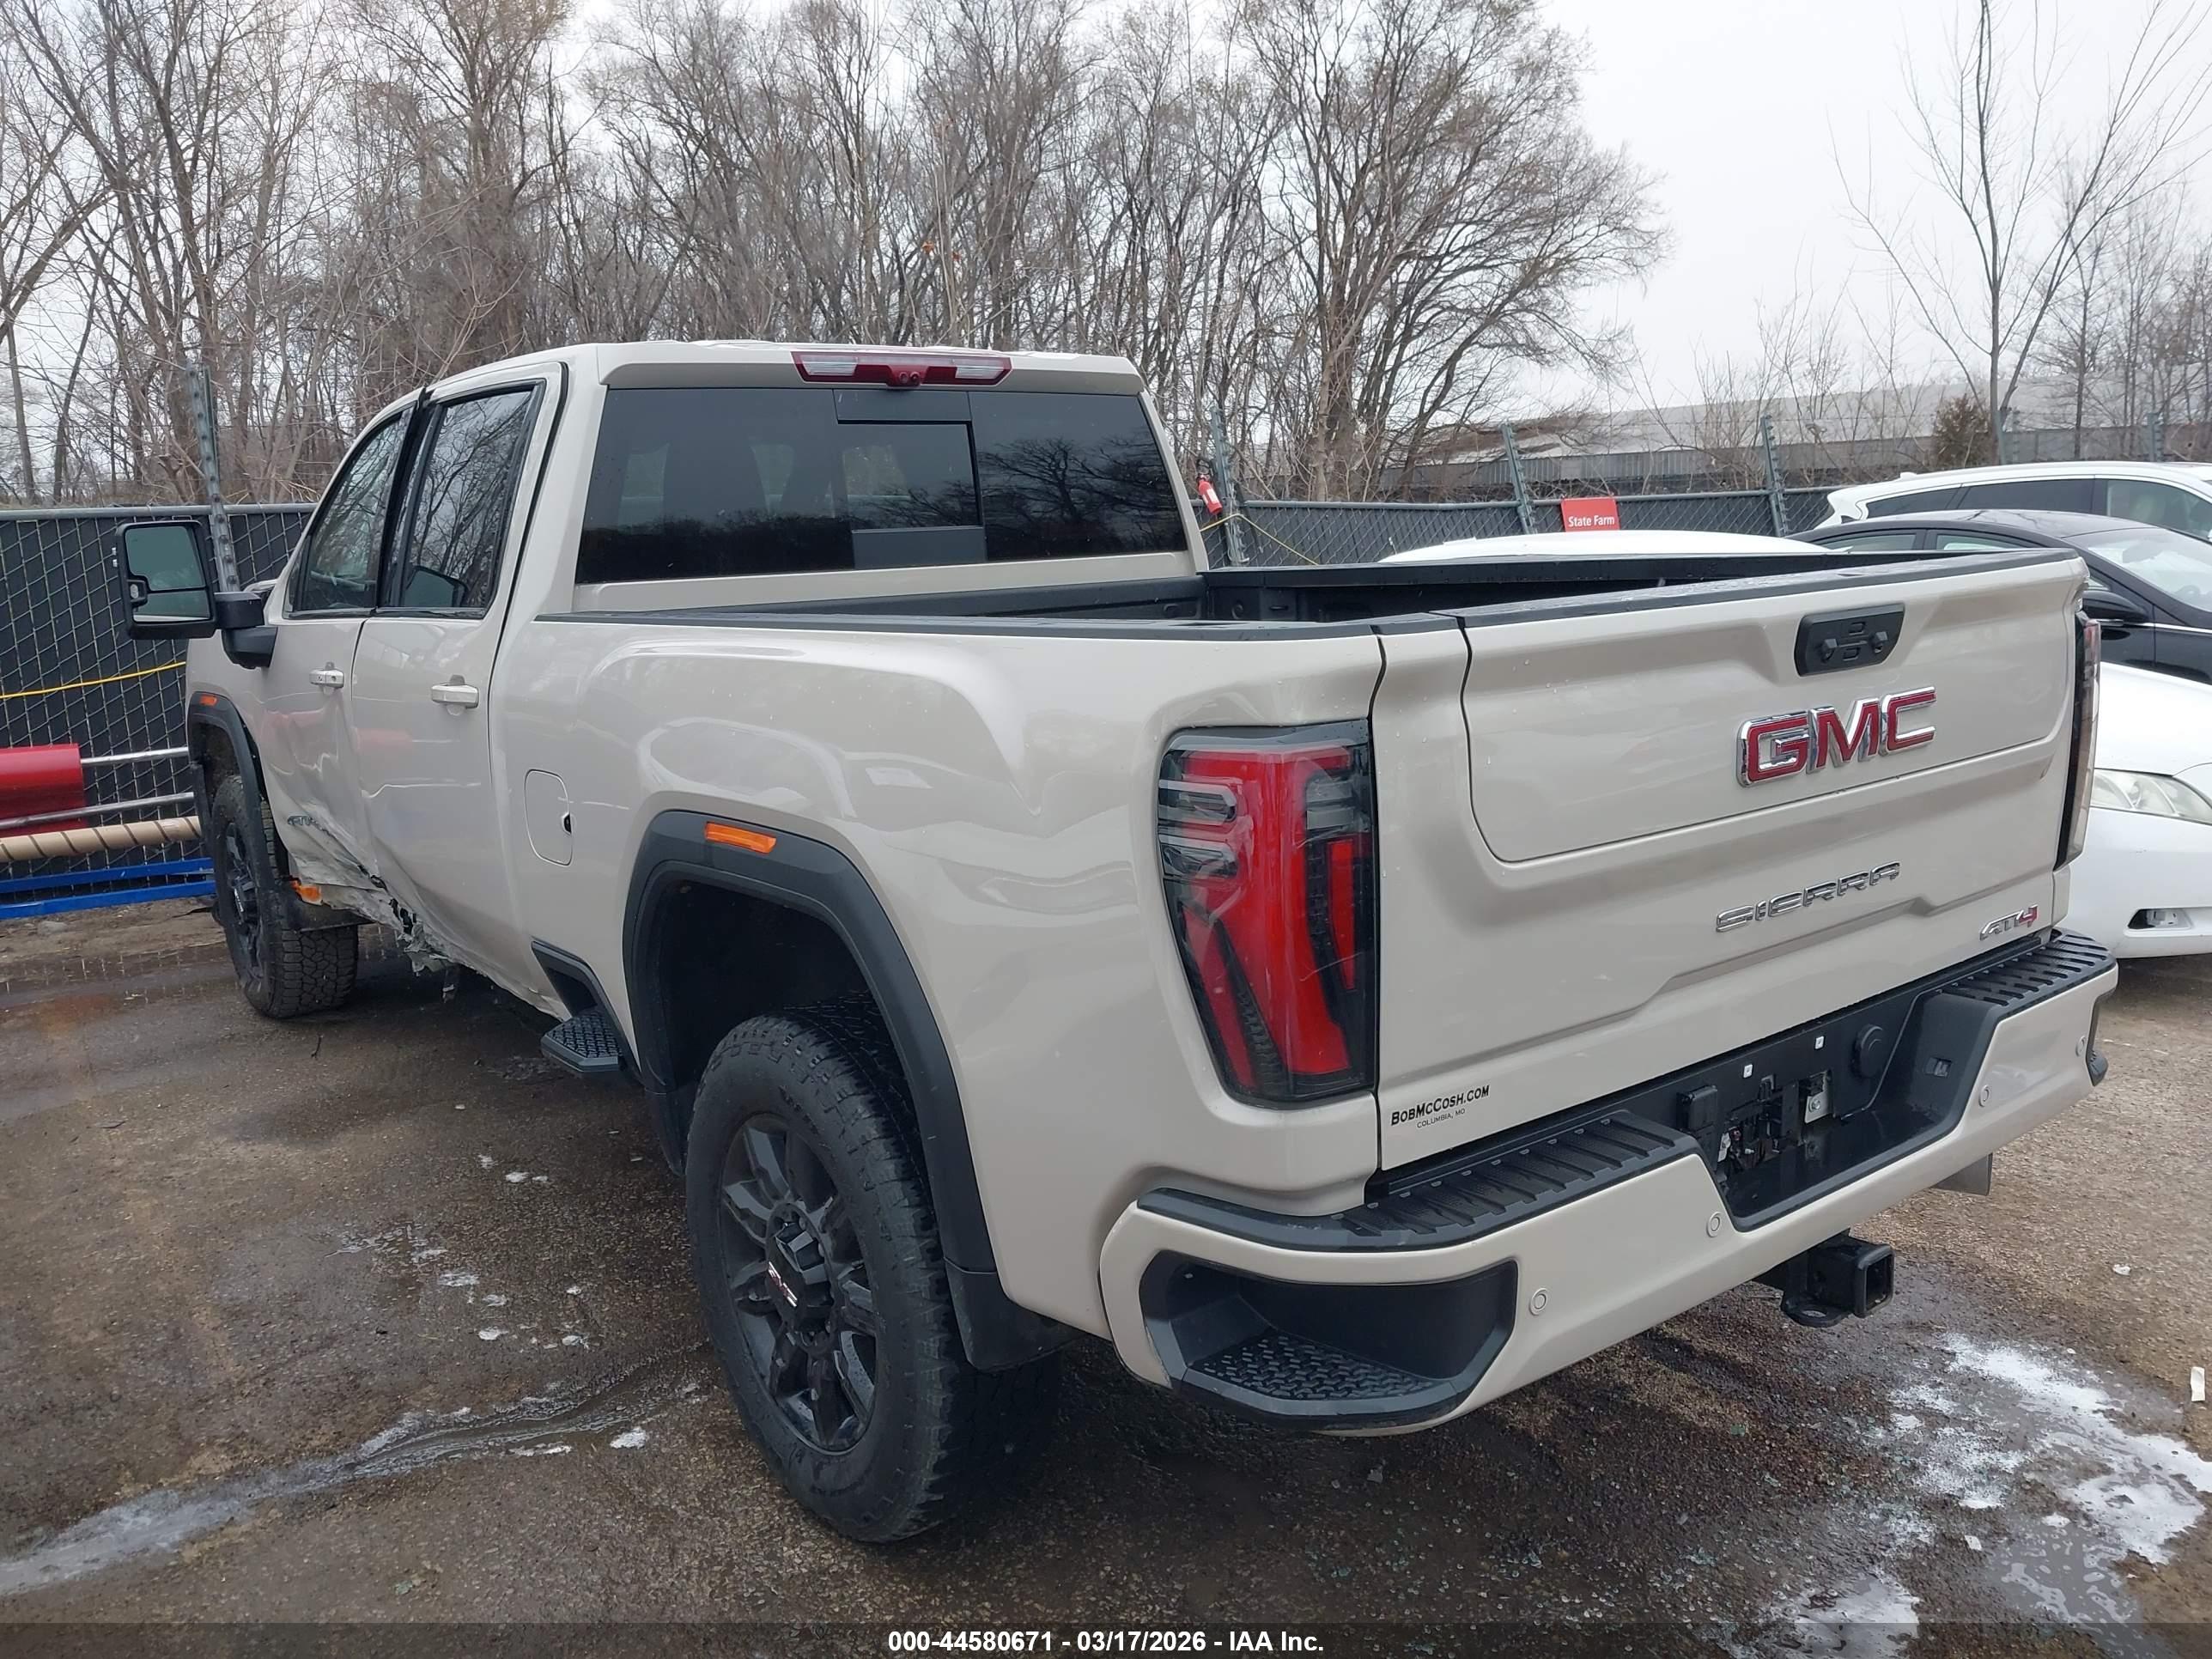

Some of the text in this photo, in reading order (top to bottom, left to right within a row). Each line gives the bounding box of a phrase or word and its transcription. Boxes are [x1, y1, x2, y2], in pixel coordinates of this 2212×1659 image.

[1568, 515, 1615, 527] State Farm
[1737, 686, 1936, 787] GMC
[1716, 860, 1900, 933] SIERRA
[1979, 904, 2038, 941] AT4
[1417, 1108, 1466, 1128] COLUMBIA, MO
